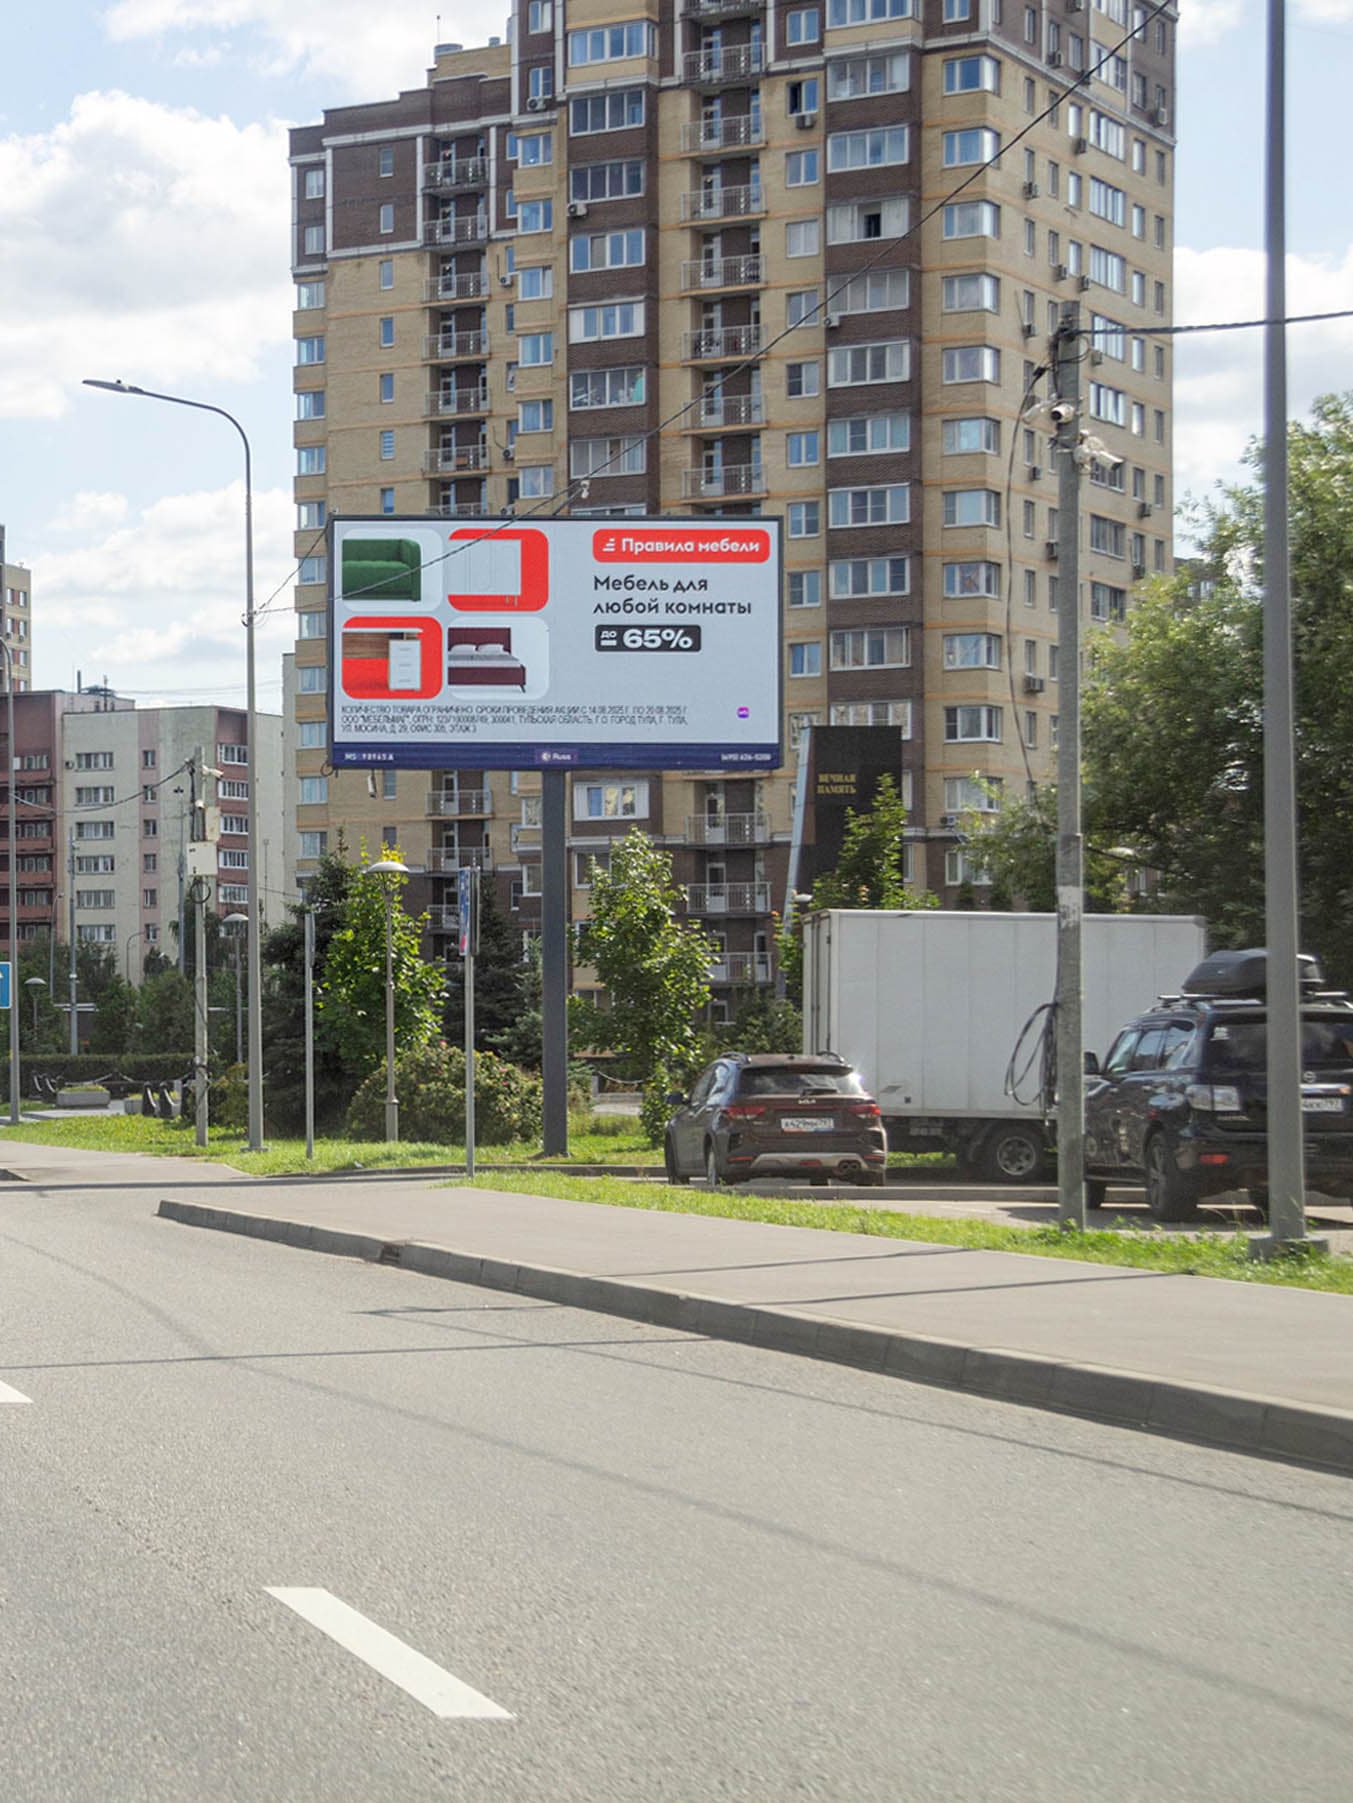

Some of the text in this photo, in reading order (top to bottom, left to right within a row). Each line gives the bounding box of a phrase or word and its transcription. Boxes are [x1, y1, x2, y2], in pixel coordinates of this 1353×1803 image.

[621, 537, 760, 555] Правила мебели
[593, 574, 708, 593] Мебель для
[593, 598, 752, 614] любой комнаты
[816, 784, 857, 794] ПАМЯТЬ
